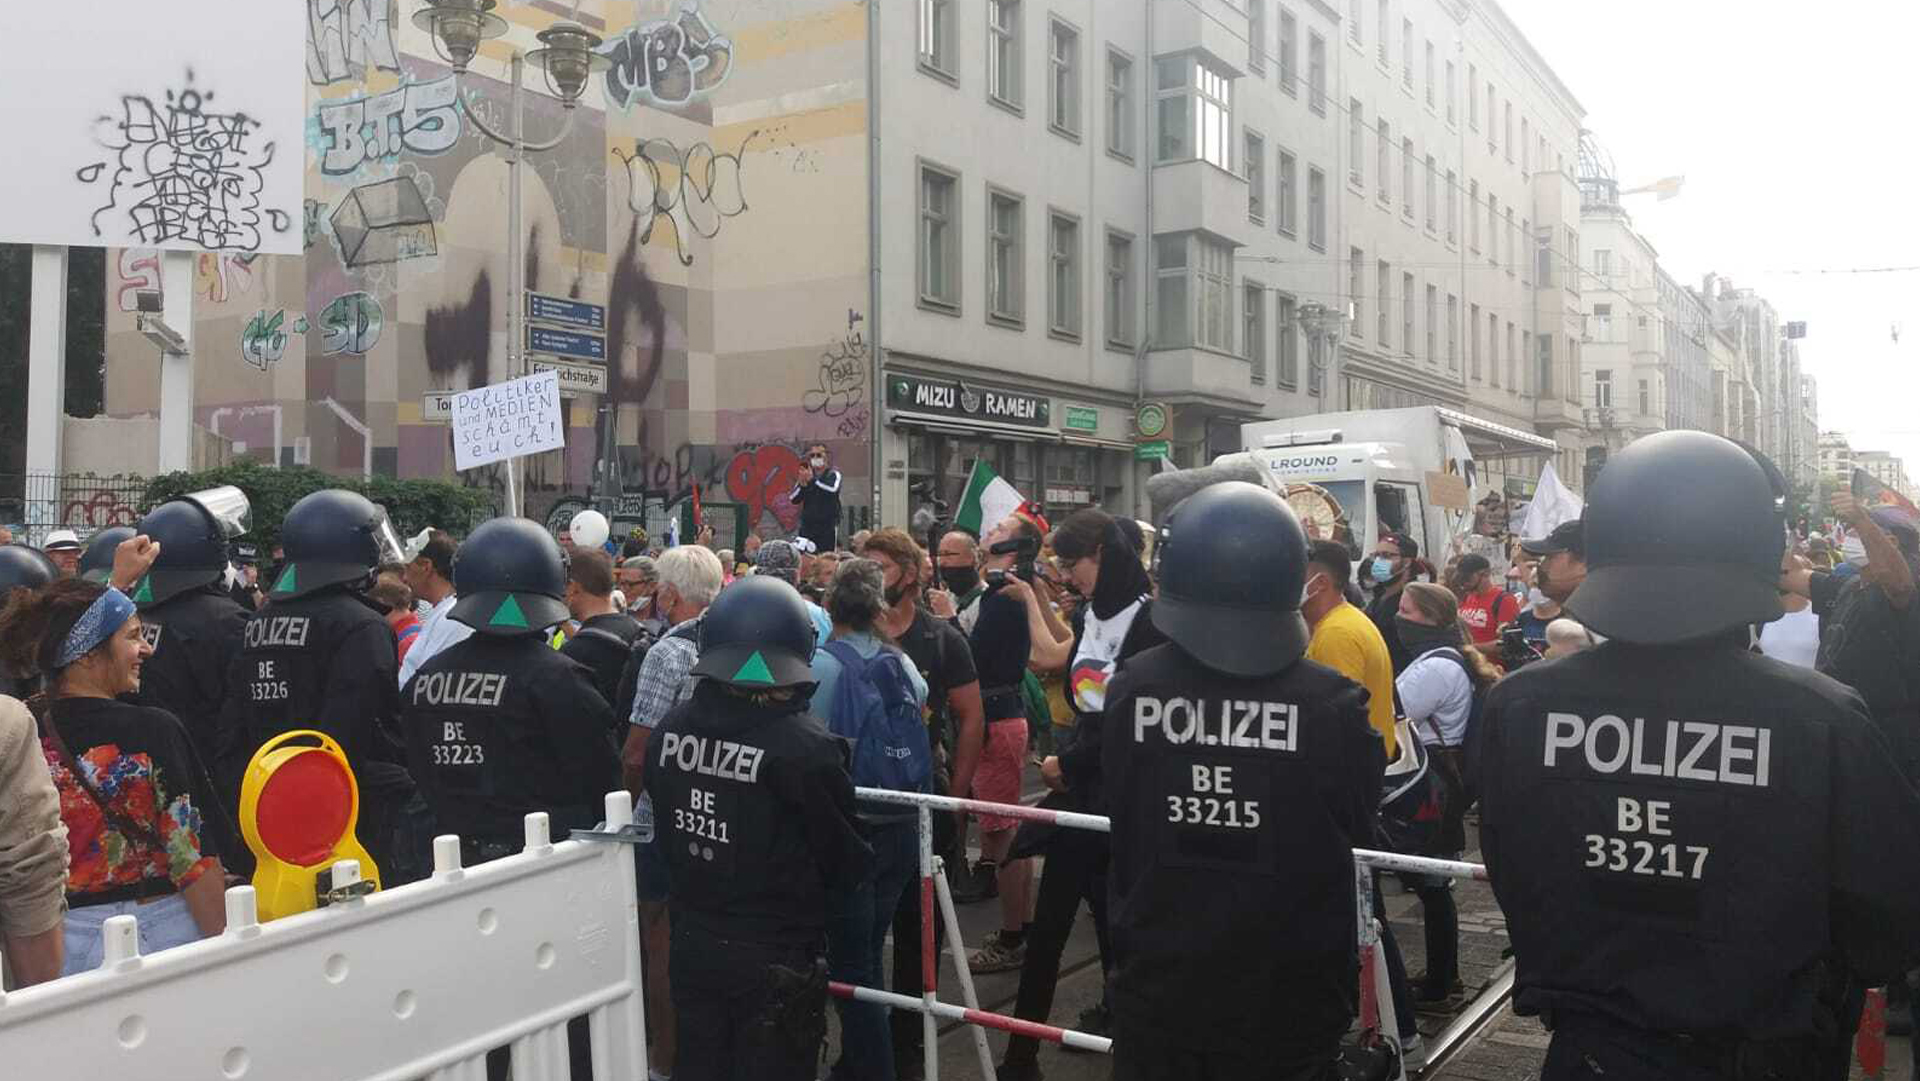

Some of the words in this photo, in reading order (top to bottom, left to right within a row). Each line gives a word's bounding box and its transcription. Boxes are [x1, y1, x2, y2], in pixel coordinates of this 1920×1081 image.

[458, 412, 481, 427] und
[485, 393, 552, 419] MEDIEN
[915, 383, 955, 408] MIZU
[985, 393, 1036, 418] RAMEN
[1270, 456, 1338, 470] LROUND
[243, 616, 310, 649] POLIZEI
[258, 660, 275, 679] BE
[413, 671, 507, 706] POLIZEI
[443, 721, 467, 741] BE
[1134, 696, 1299, 752] POLIZEI
[431, 744, 485, 765] 33223
[659, 732, 765, 783] POLIZEI
[1543, 712, 1772, 787] POLIZEI
[1191, 764, 1234, 794] BE
[690, 787, 716, 815] BE
[1167, 795, 1261, 829] 33215
[1617, 797, 1673, 836] BE
[674, 808, 730, 844] 33211
[1585, 834, 1710, 880] 33217
